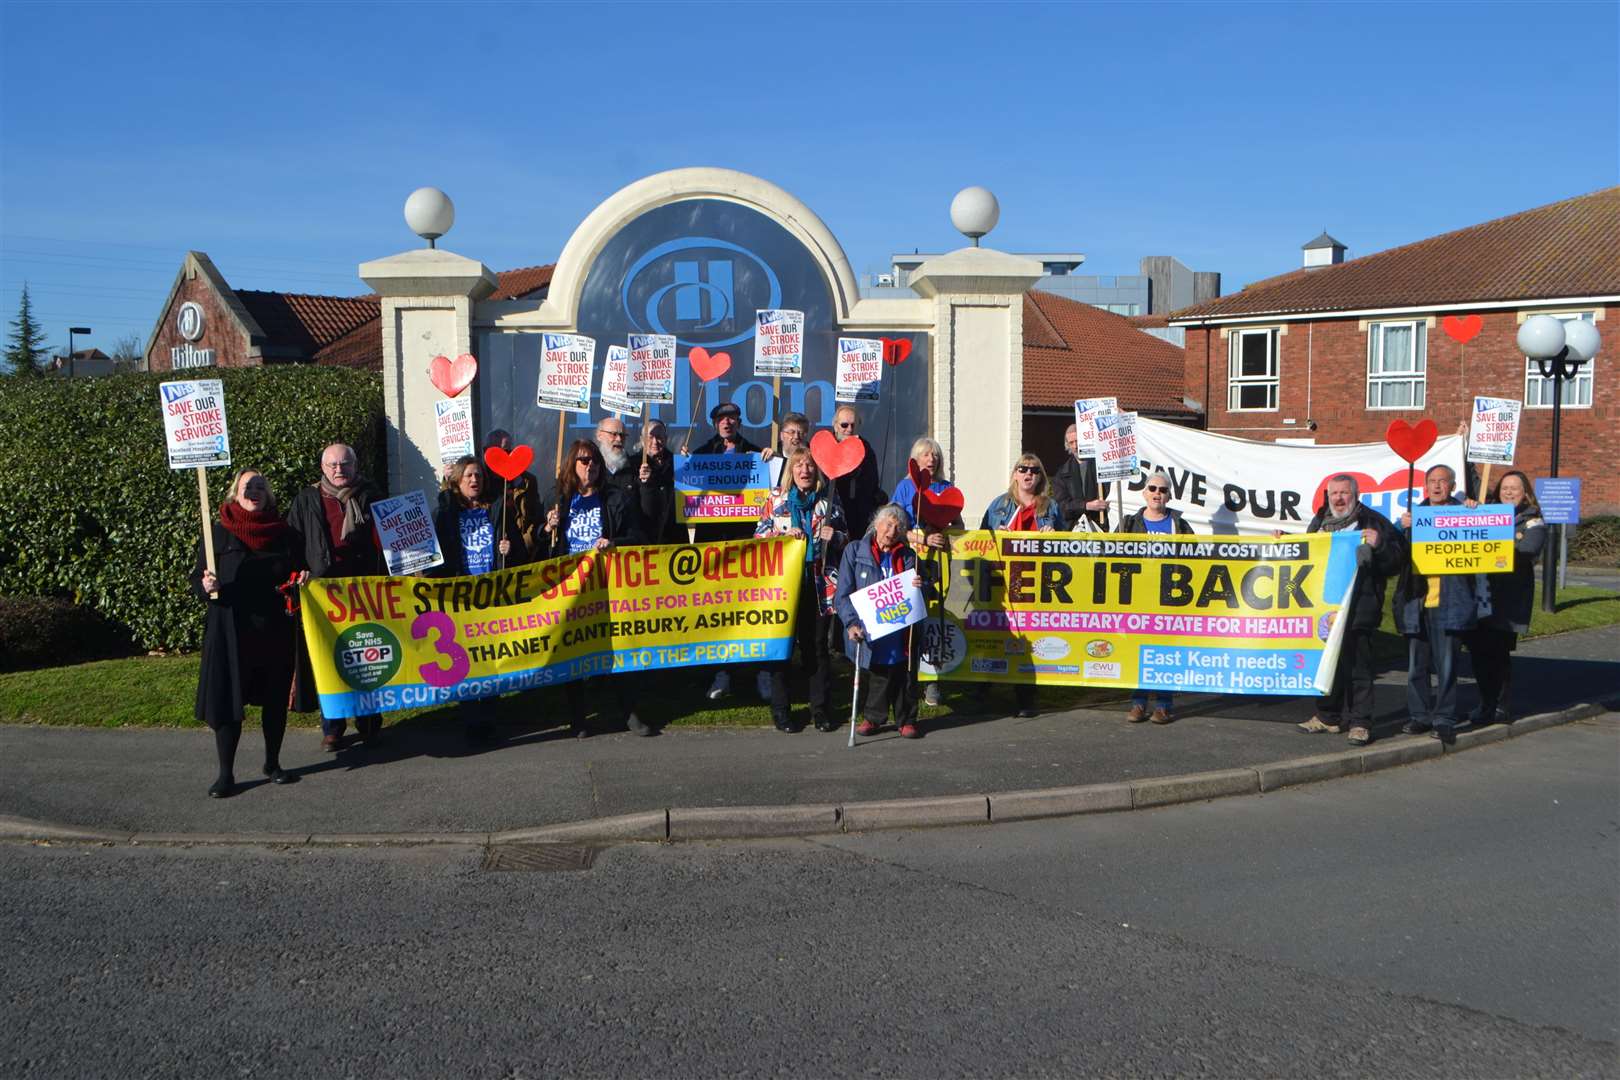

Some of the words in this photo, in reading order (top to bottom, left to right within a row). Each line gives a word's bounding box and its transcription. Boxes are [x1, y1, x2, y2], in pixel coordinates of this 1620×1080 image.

[760, 326, 779, 335] SAVE
[782, 324, 797, 333] OUR
[770, 334, 800, 344] STROKE
[632, 351, 651, 360] SAVE
[653, 349, 669, 358] OUR
[762, 344, 799, 355] SERVICES
[171, 343, 211, 369] Hilton
[546, 352, 567, 362] SAVE
[570, 352, 587, 362] OUR
[792, 355, 799, 366] 3
[842, 353, 861, 362] SAVE
[862, 352, 877, 361] OUR
[557, 363, 590, 374] STROKE
[642, 359, 672, 370] STROKE
[852, 362, 879, 372] STROKE
[547, 375, 588, 385] SERVICES
[634, 370, 671, 381] SERVICES
[843, 372, 878, 382] SERVICES
[664, 380, 671, 393] 3
[580, 387, 587, 400] 3
[168, 401, 193, 416] SAVE
[195, 396, 216, 410] OUR
[182, 409, 221, 427] STROKE
[439, 414, 451, 427] SAVE
[452, 410, 466, 421] OUR
[1476, 413, 1496, 422] SAVE
[1499, 412, 1513, 420] OUR
[175, 422, 222, 442] SERVICES
[445, 420, 470, 434] STROKE
[1486, 422, 1515, 431] STROKE
[441, 430, 470, 447] SERVICES
[1098, 429, 1118, 441] SAVE
[1119, 426, 1132, 436] OUR
[1476, 433, 1512, 441] SERVICES
[215, 435, 224, 453] 3
[1109, 435, 1136, 449] STROKE
[1103, 446, 1136, 461] SERVICES
[684, 462, 690, 471] 3
[693, 461, 732, 470] HASUS
[735, 461, 757, 470] ARE
[1131, 456, 1137, 468] 3
[682, 476, 704, 485] NOT
[708, 474, 760, 485] ENOUGH!
[1128, 460, 1207, 507] SVE
[1223, 484, 1302, 520] OUR
[692, 495, 736, 505] THANET
[569, 507, 601, 518] SAVE
[684, 506, 710, 517] WILL
[713, 506, 760, 516] SUFFER!
[381, 514, 403, 531] SAVE
[404, 506, 424, 521] OUR
[459, 517, 488, 527] SAVE
[571, 518, 600, 527] OUR
[1416, 518, 1431, 527] AN
[1435, 515, 1511, 527] EXPERIMENT
[396, 516, 430, 537] STROKE
[460, 526, 489, 535] OUR
[569, 527, 602, 538] NHS
[390, 528, 432, 552] SERVICES
[1438, 530, 1457, 540] ON
[1462, 529, 1488, 539] THE
[462, 535, 491, 547] NHS
[964, 540, 995, 555] says
[1011, 540, 1039, 553] THE
[1043, 540, 1101, 554] STROKE
[1105, 541, 1176, 556] DECISION
[1180, 543, 1215, 556] MAY
[1219, 544, 1258, 557] COST
[1261, 544, 1300, 557] LIVES
[1425, 543, 1479, 554] PEOPLE
[1483, 542, 1501, 553] OF
[1446, 557, 1481, 568] KENT
[327, 581, 406, 623] SAVE
[413, 570, 532, 615] STROKE
[541, 549, 660, 600] SERVICE
[868, 578, 903, 600] SAVE
[1092, 562, 1141, 604] IT
[1160, 564, 1314, 610] BACK
[875, 591, 905, 609] OUR
[880, 603, 909, 622] NHS
[968, 611, 991, 626] TO
[995, 612, 1026, 628] THE
[1030, 611, 1121, 631] SECRETARY
[1127, 615, 1149, 631] OF
[1154, 615, 1203, 632] STATE
[1207, 617, 1240, 634] FOR
[1245, 618, 1308, 634] HEALTH
[925, 623, 955, 636] AVE
[364, 637, 382, 645] NHS
[411, 611, 470, 687] 3
[464, 610, 561, 638] EXCELLENT
[565, 597, 651, 622] HOSPITALS
[655, 595, 688, 610] FOR
[692, 591, 733, 606] EAST
[737, 587, 787, 602] KENT:
[468, 635, 557, 663] THANET,
[563, 616, 689, 646] CANTERBURY,
[695, 609, 789, 629] ASHFORD
[1143, 649, 1182, 667] East
[1188, 651, 1230, 669] Kent
[1236, 653, 1287, 669] needs
[1294, 653, 1305, 669] 3
[1092, 663, 1114, 671] CWU
[359, 690, 396, 711] NHS
[402, 686, 451, 705] CUTS
[457, 678, 503, 698] COST
[509, 669, 553, 690] LIVES
[571, 652, 624, 677] LISTEN
[632, 651, 652, 667] TO
[657, 647, 691, 664] THE
[695, 642, 767, 661] PEOPLE!
[1143, 668, 1224, 687] Excellent
[1230, 671, 1313, 691] Hospitals
